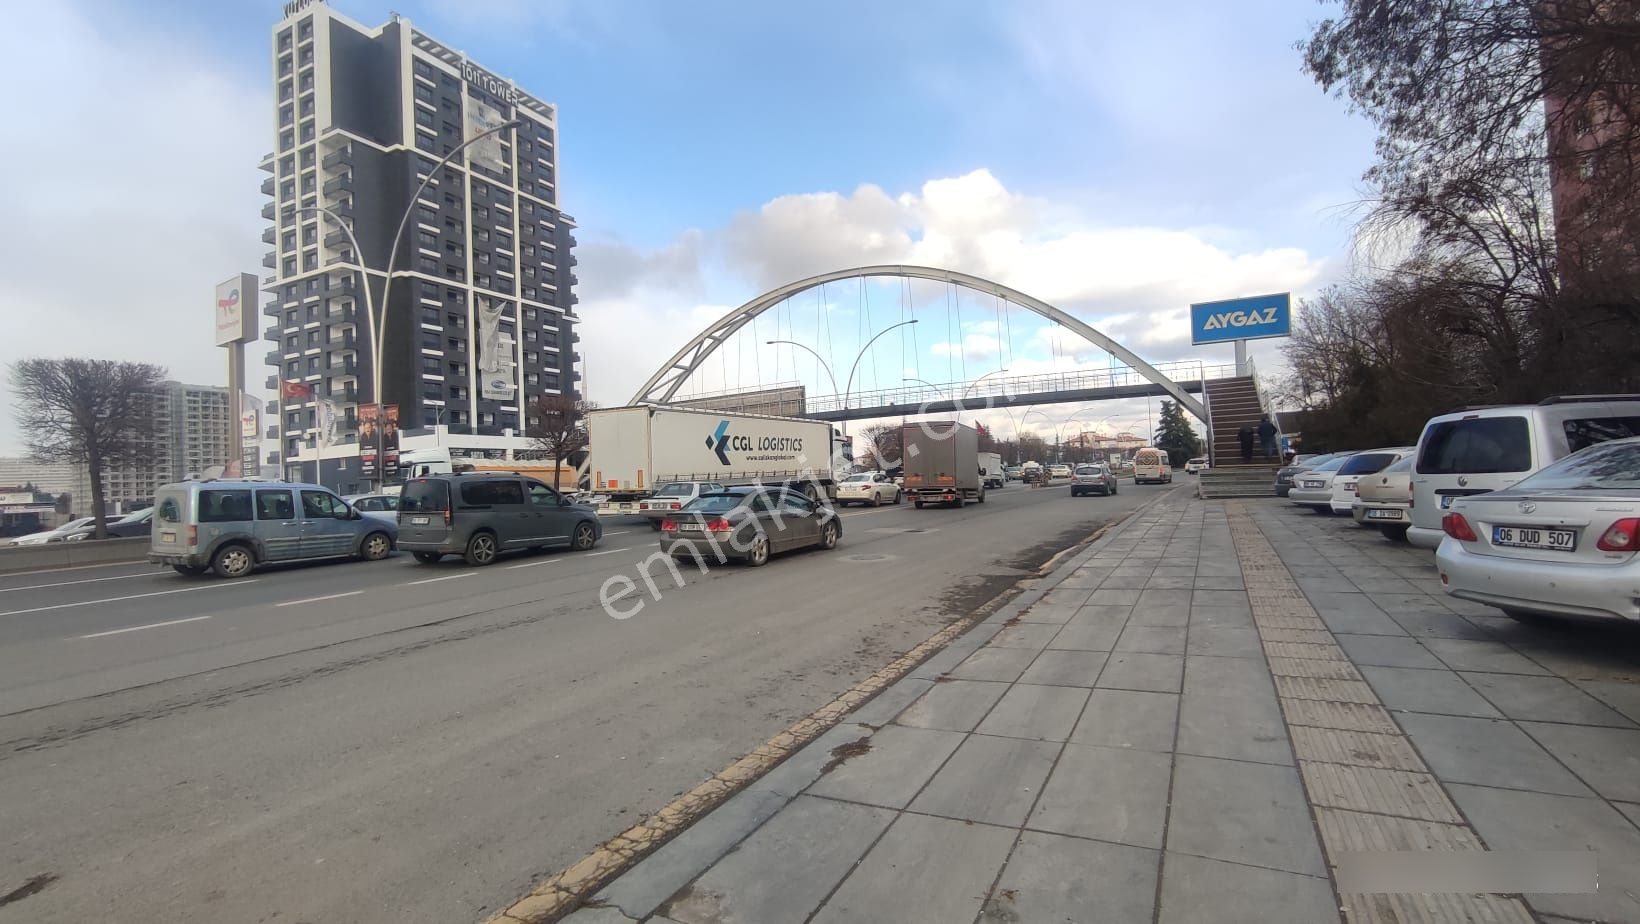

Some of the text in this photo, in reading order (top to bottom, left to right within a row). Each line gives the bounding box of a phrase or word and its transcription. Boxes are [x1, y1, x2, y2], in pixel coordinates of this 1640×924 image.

[482, 75, 519, 107] TOWER
[1203, 307, 1278, 330] AYGAZ
[732, 435, 803, 452] CGL LOGISTICS
[1500, 529, 1572, 546] 06 DUD 507
